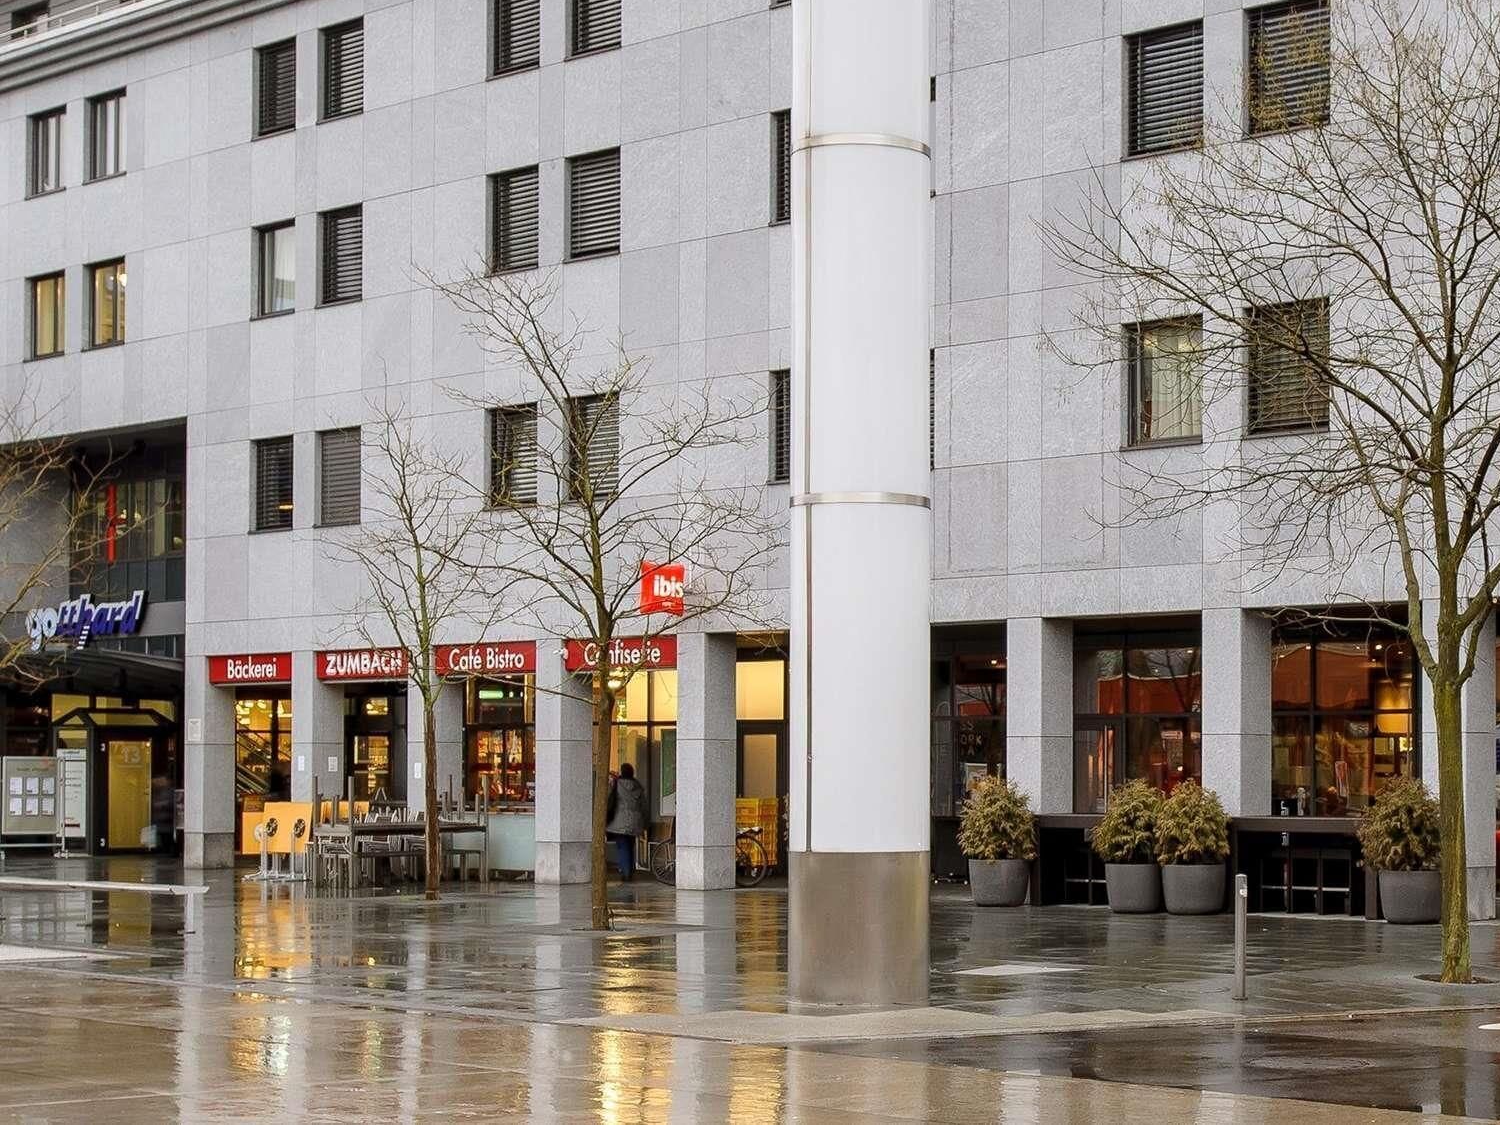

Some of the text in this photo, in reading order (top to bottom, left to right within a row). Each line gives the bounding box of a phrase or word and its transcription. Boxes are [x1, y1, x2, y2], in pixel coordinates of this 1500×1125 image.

[653, 574, 684, 597] ibis
[25, 590, 144, 651] gotthard
[227, 656, 277, 679] Bäckerei
[325, 650, 402, 676] ZUMBACH
[449, 647, 525, 670] Café Bistro
